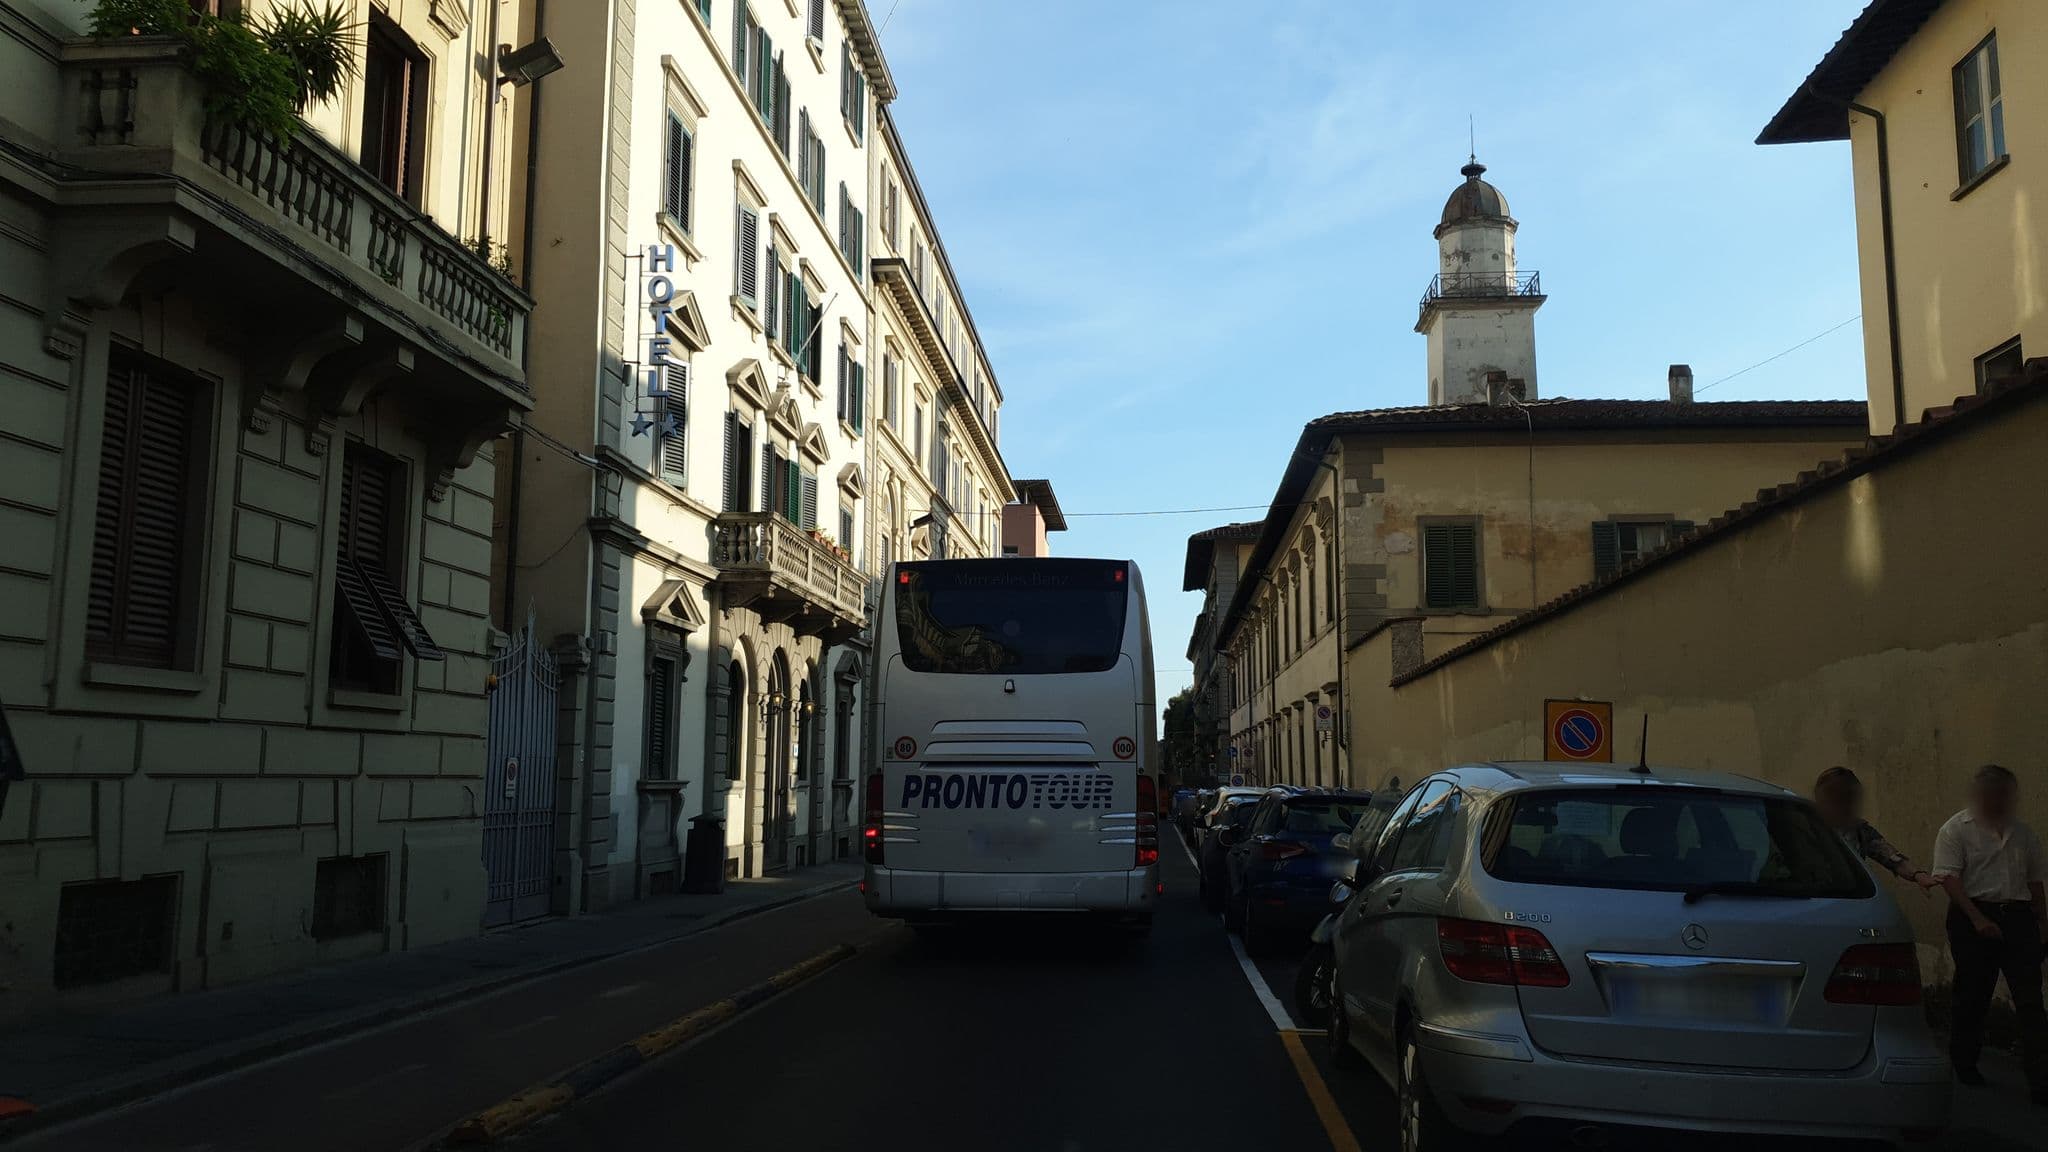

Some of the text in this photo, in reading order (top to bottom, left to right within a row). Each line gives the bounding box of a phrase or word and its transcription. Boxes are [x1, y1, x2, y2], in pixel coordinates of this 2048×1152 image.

[648, 244, 674, 397] HOTEL
[900, 743, 912, 753] 80
[1117, 743, 1132, 753] 100
